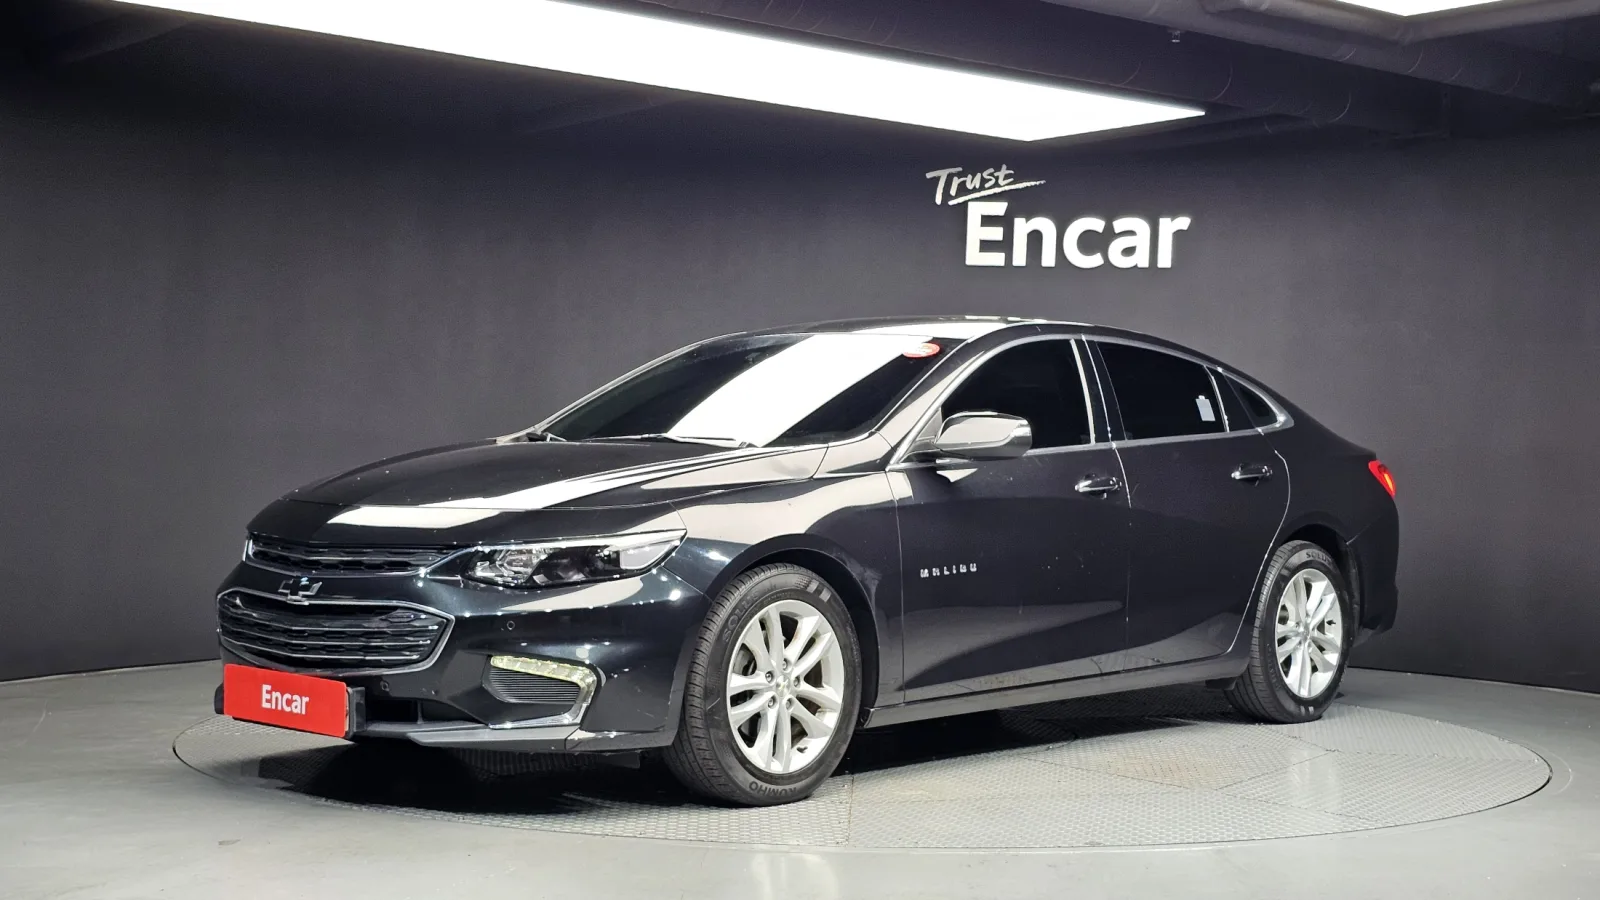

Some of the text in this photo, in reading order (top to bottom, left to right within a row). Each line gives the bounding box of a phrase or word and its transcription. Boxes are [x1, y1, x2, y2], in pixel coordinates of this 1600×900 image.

[926, 164, 1016, 205] Trust
[965, 201, 1192, 269] Encar
[920, 563, 977, 578] MALIBU
[261, 684, 310, 715] Encar
[749, 780, 797, 796] KUMHO
